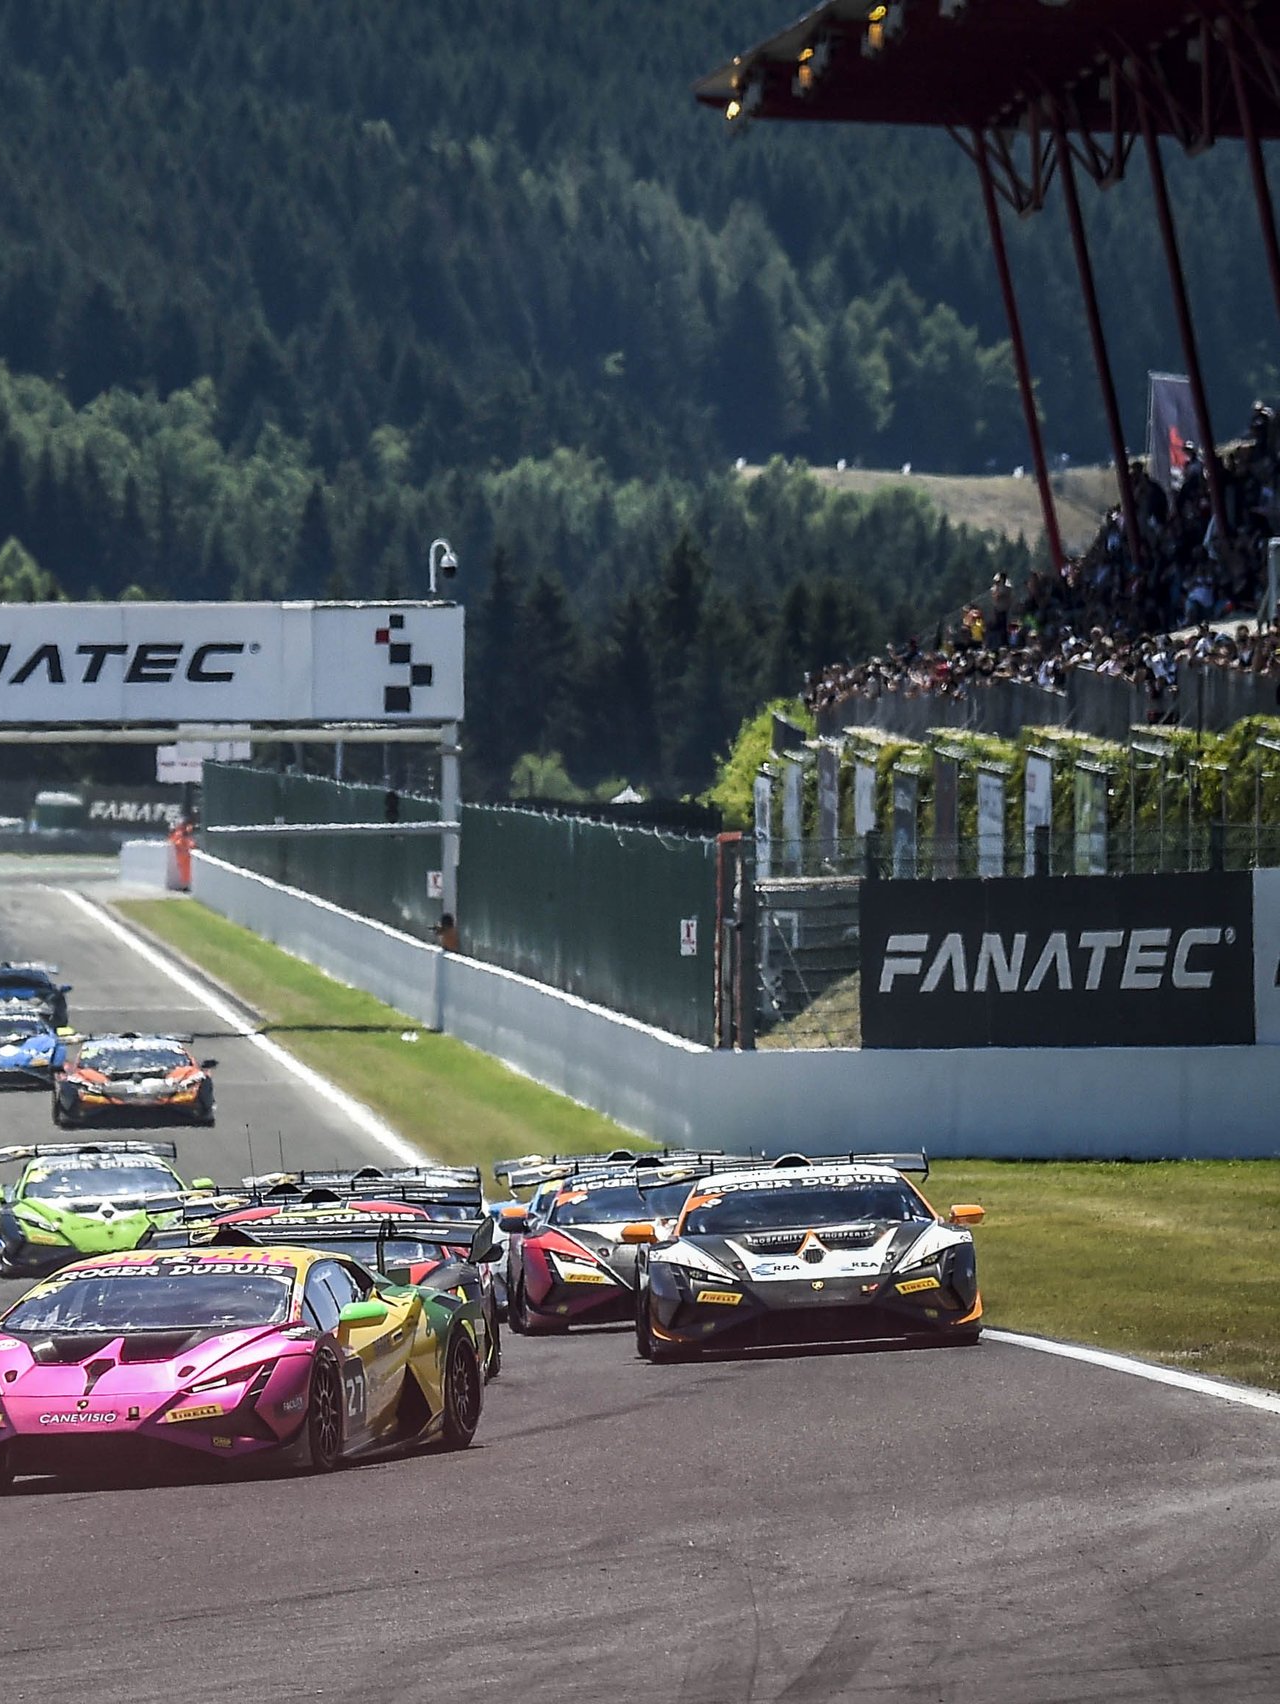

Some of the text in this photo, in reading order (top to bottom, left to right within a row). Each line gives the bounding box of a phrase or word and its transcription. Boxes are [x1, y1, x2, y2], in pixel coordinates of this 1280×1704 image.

[878, 927, 1222, 993] FANATEC
[572, 1178, 637, 1192] ROGE
[704, 1174, 897, 1194] ROGER DUBUIS
[56, 1263, 286, 1283] ROGER DUBUIS
[901, 1279, 936, 1292] PIRELLI
[702, 1293, 738, 1303] PIRELLI
[345, 1375, 365, 1417] 27
[39, 1412, 117, 1425] CANEVISIO
[170, 1404, 218, 1420] PIRELLI
